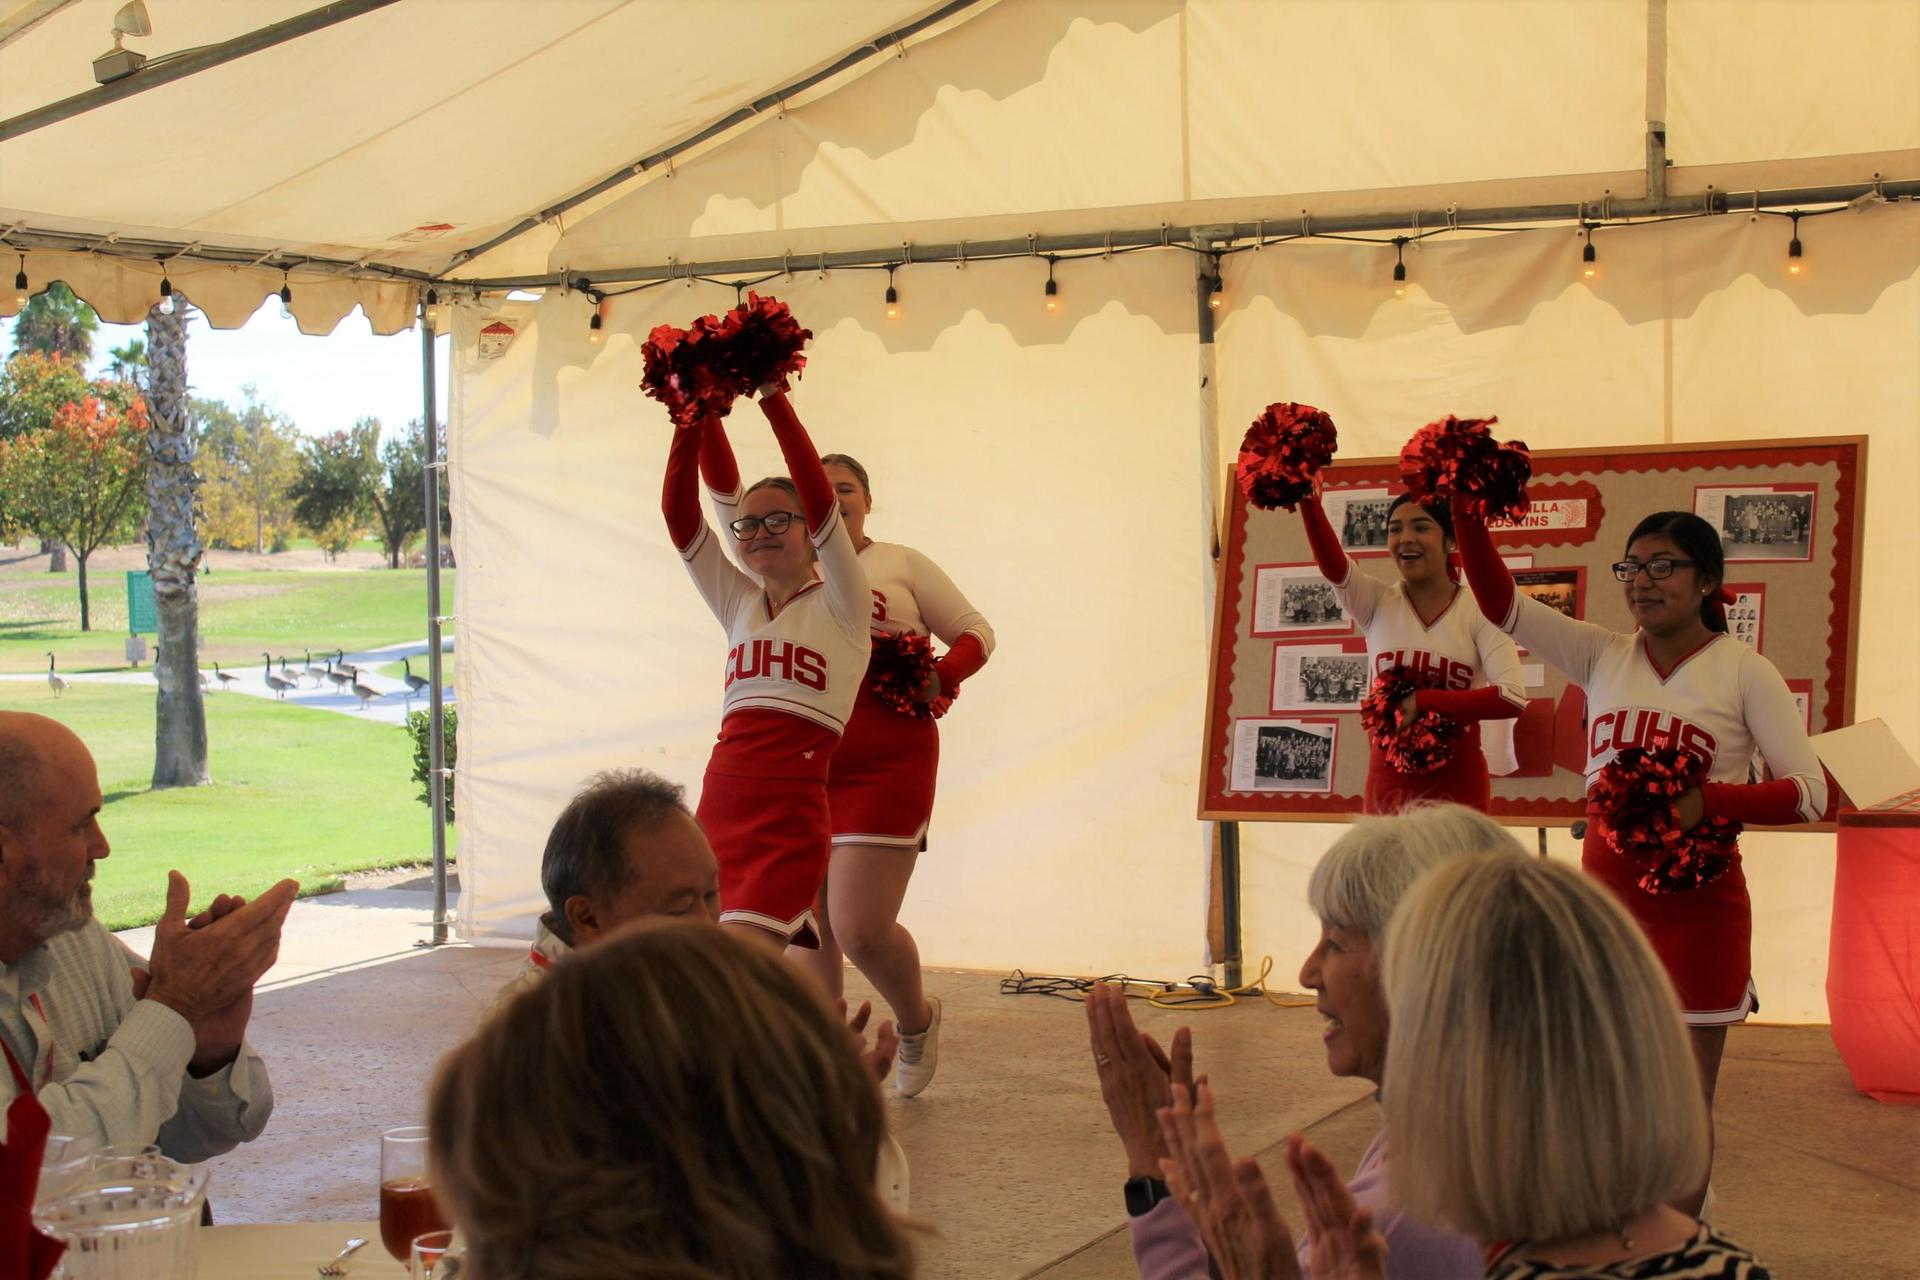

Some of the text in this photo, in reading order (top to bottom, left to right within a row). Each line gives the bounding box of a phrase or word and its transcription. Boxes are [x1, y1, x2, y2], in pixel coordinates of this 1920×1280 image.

[1529, 502, 1559, 513] ILLA
[725, 639, 828, 693] CUHS
[1375, 650, 1474, 691] CUHS
[1590, 709, 1718, 775] CUHS
